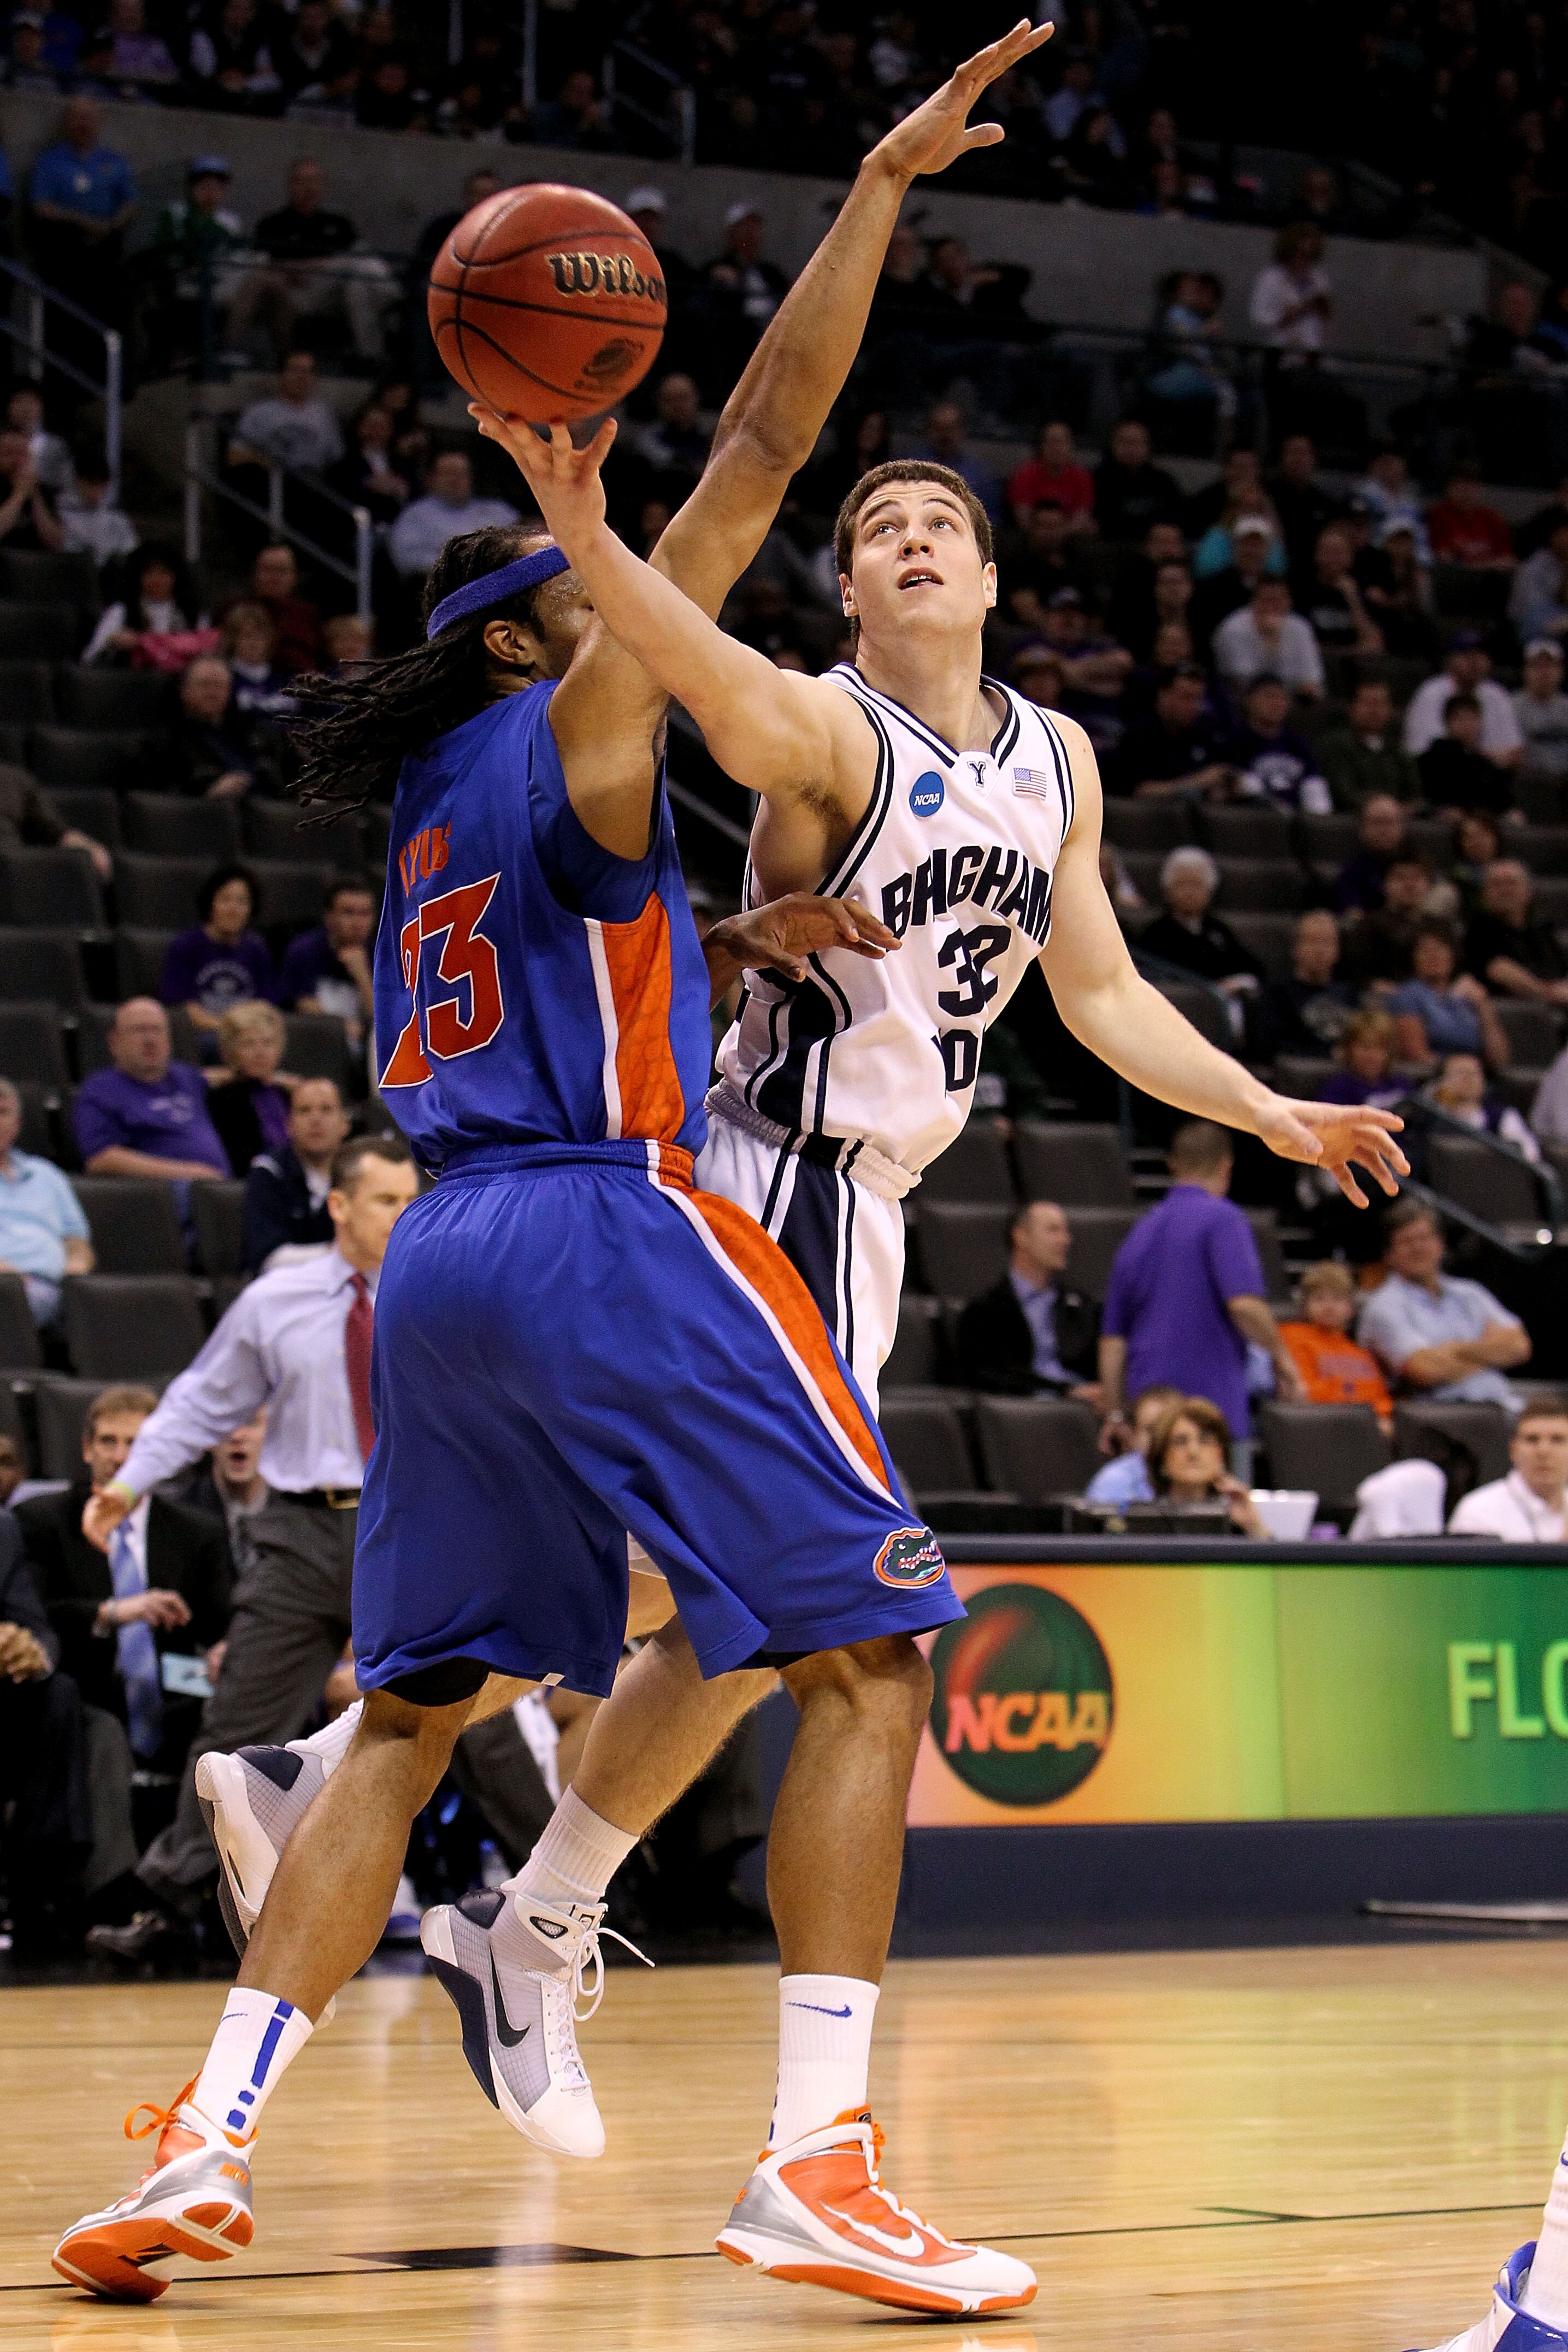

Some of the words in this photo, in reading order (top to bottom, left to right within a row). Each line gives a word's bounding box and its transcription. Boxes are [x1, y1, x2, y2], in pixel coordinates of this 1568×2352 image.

[966, 761, 986, 788] Y
[913, 792, 940, 807] NCAA
[938, 924, 1012, 1017] 32
[945, 1691, 1109, 1753] NCAA
